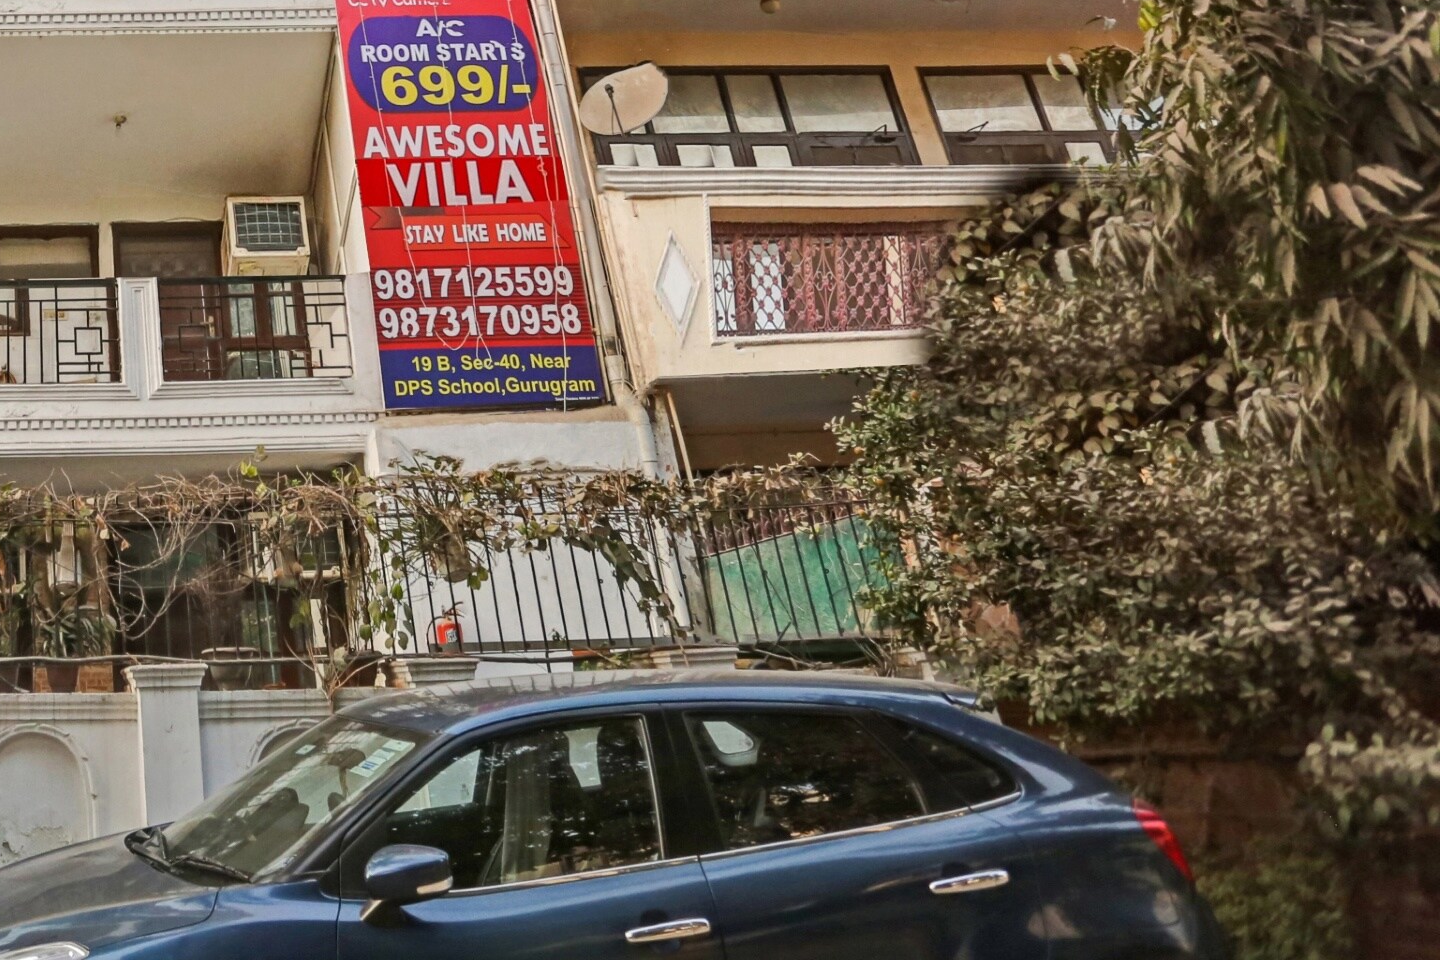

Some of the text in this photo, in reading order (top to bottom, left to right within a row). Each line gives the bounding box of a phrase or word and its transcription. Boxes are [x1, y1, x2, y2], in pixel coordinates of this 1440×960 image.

[360, 40, 526, 63] ROOM STARTS
[380, 64, 532, 106] 699/-
[363, 123, 550, 159] AWESOME
[385, 159, 534, 207] VILLA
[405, 222, 546, 244] STAY LIKE HOME
[374, 266, 573, 300] 9817125599
[379, 304, 582, 339] 9873170958
[411, 353, 571, 373] 19 B, Sec-40, Near
[394, 380, 433, 396] DPS
